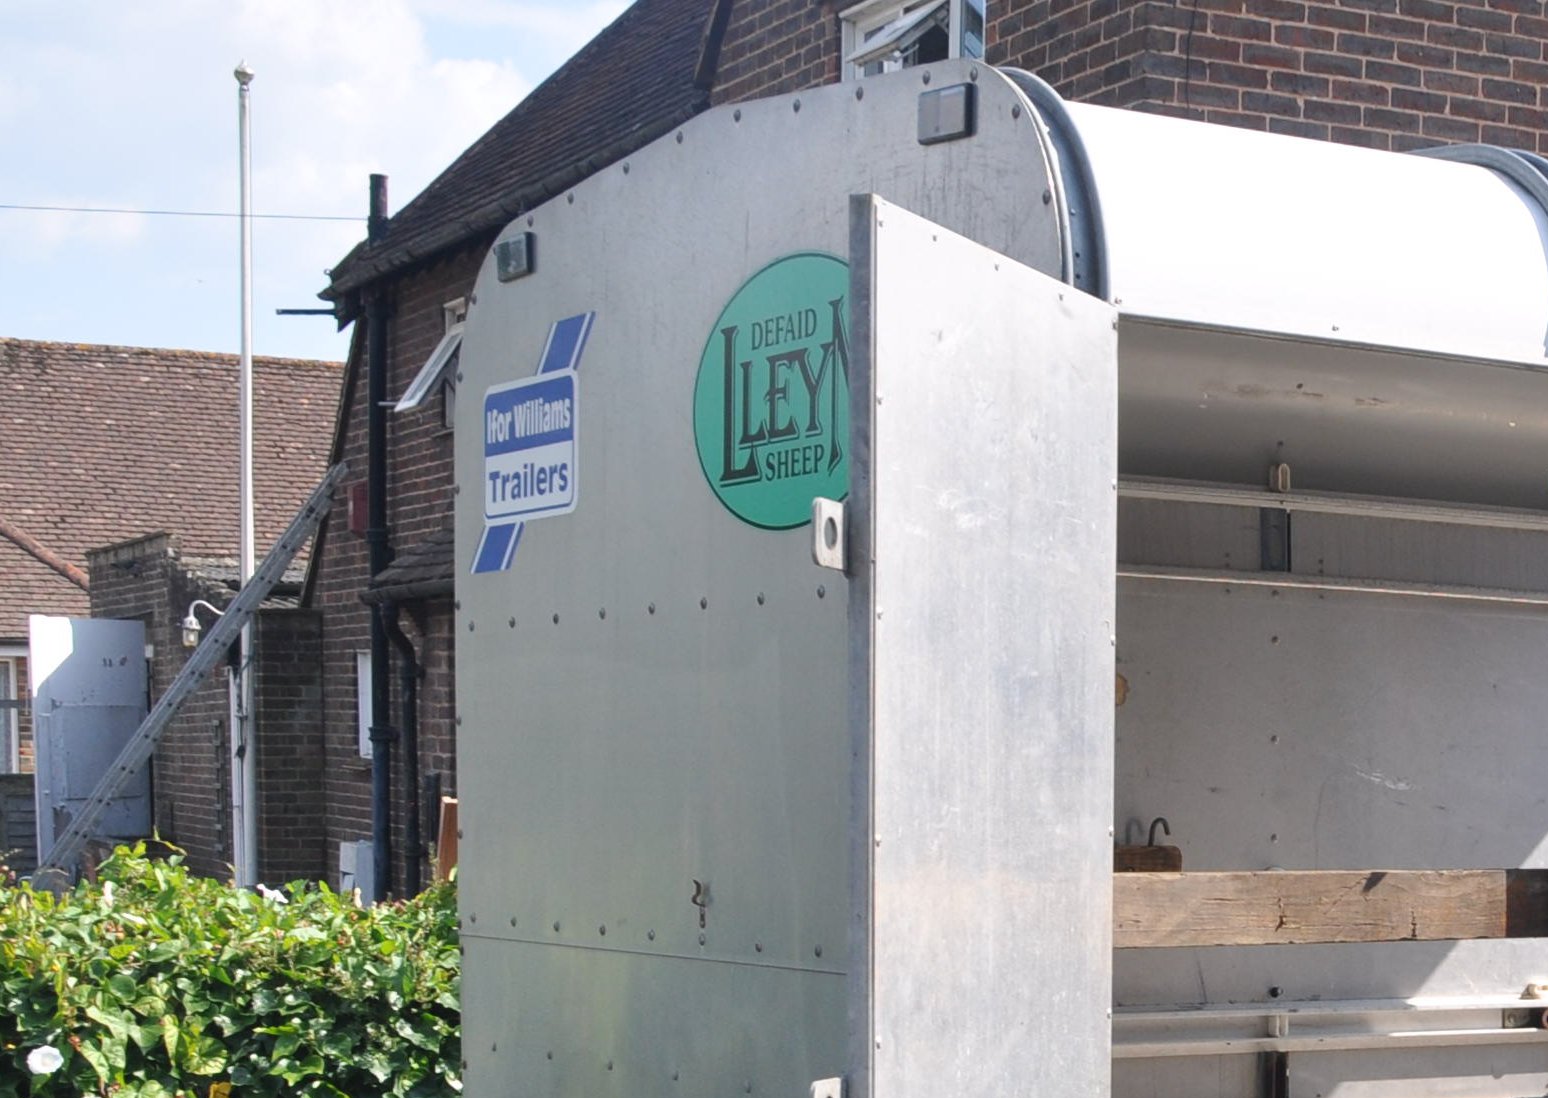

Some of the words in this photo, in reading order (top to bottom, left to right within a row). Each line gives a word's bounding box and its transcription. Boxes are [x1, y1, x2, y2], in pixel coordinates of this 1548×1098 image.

[750, 308, 818, 351] DEFAID
[487, 408, 512, 444] Ifor
[513, 397, 571, 439] Williams
[488, 462, 569, 503] Trailers
[764, 444, 826, 482] SHEEP
